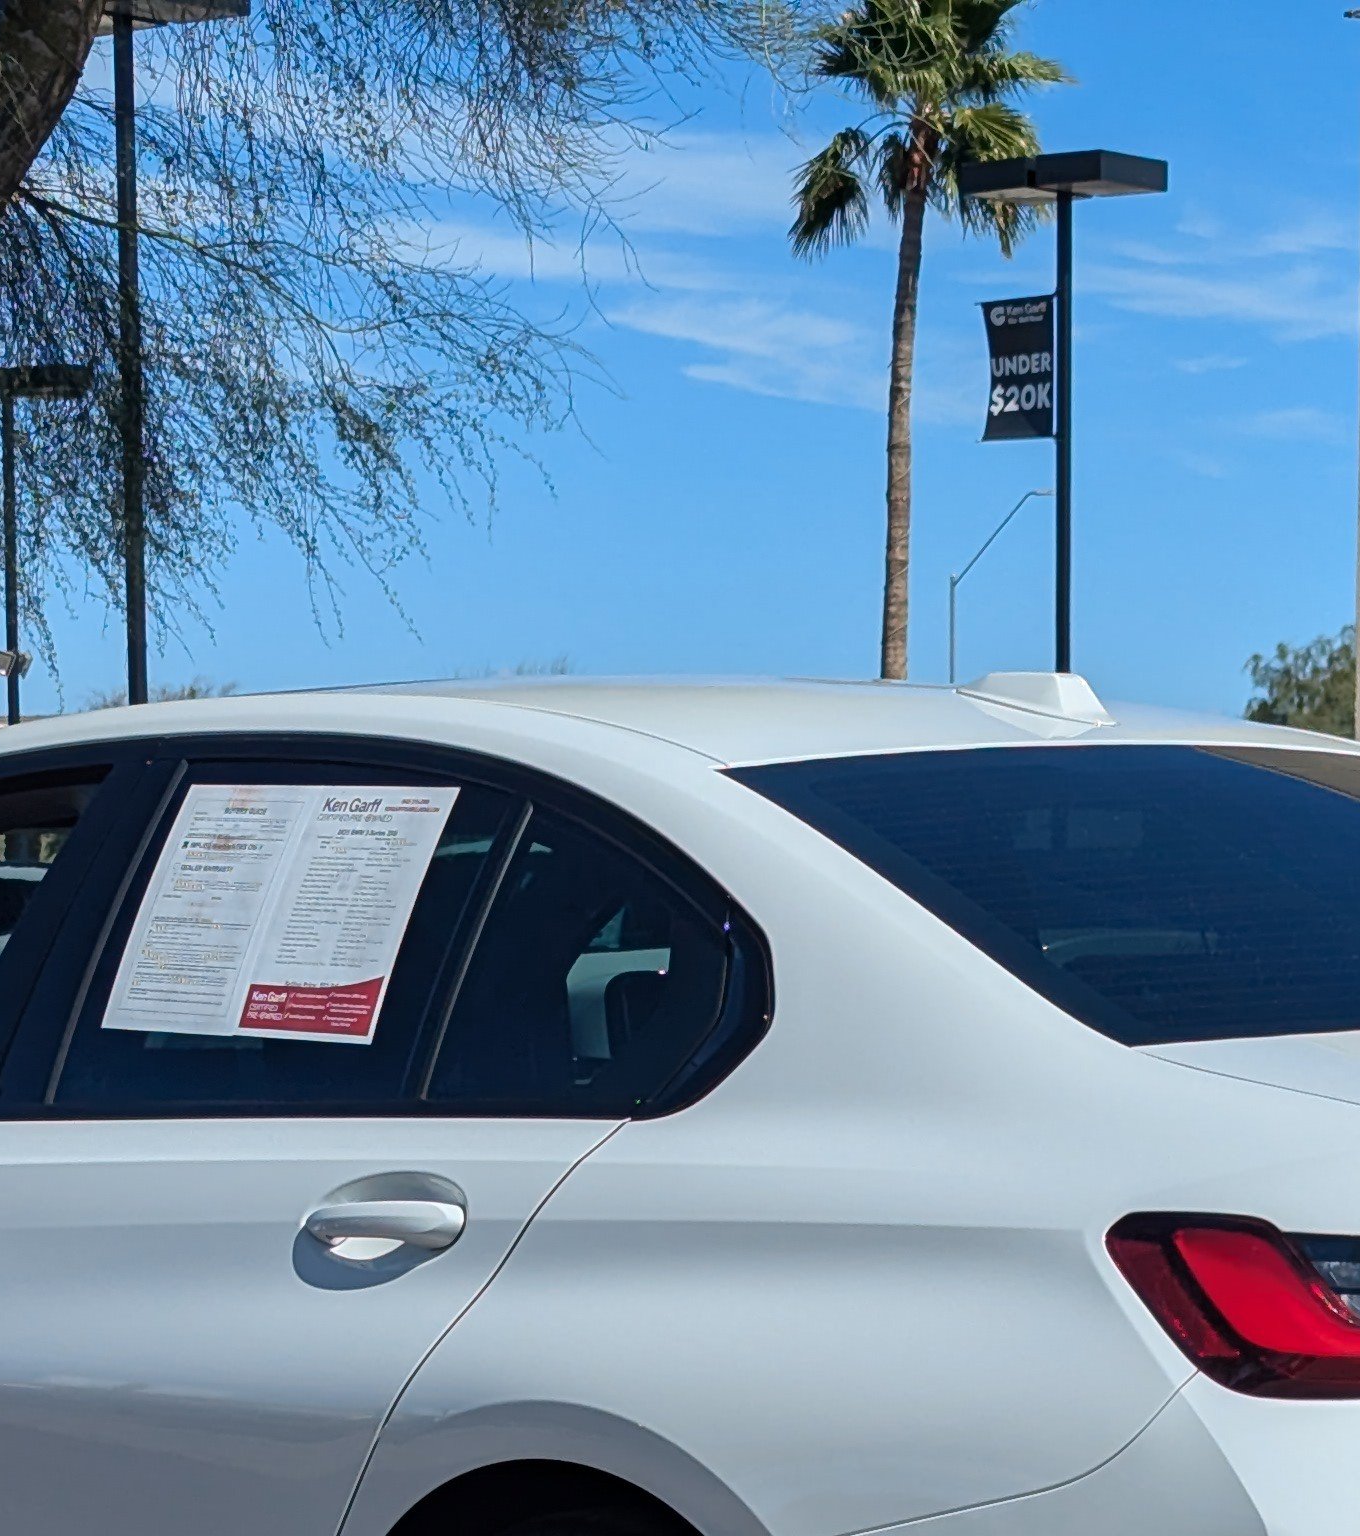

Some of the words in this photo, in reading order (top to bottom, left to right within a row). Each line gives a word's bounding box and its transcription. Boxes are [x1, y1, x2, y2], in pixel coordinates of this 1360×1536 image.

[991, 352, 1051, 377] UNDER
[990, 382, 1051, 416] $20K
[322, 797, 348, 812] Ken
[348, 797, 383, 812] Garff
